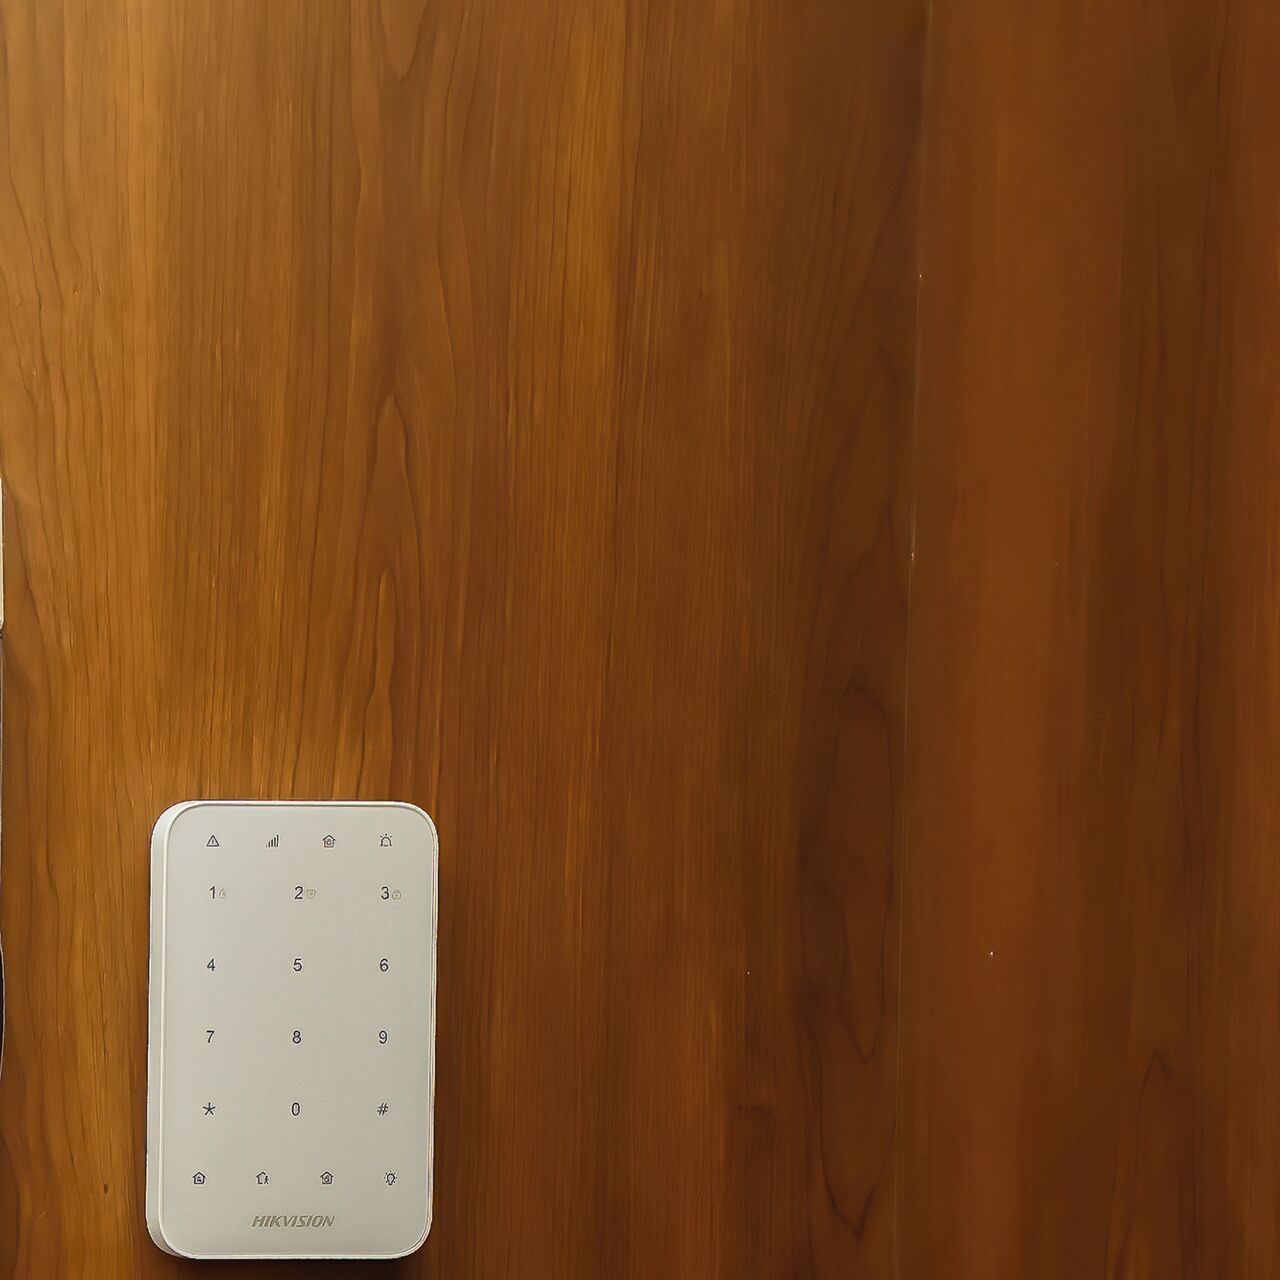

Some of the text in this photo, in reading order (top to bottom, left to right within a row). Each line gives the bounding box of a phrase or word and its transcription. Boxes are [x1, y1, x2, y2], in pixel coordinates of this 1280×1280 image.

[209, 885, 392, 901] 1 2 3
[206, 957, 389, 973] 4 5 6
[205, 1029, 388, 1045] 7 8 9
[291, 1102, 301, 1117] 0
[251, 1215, 336, 1228] HIKVISION
